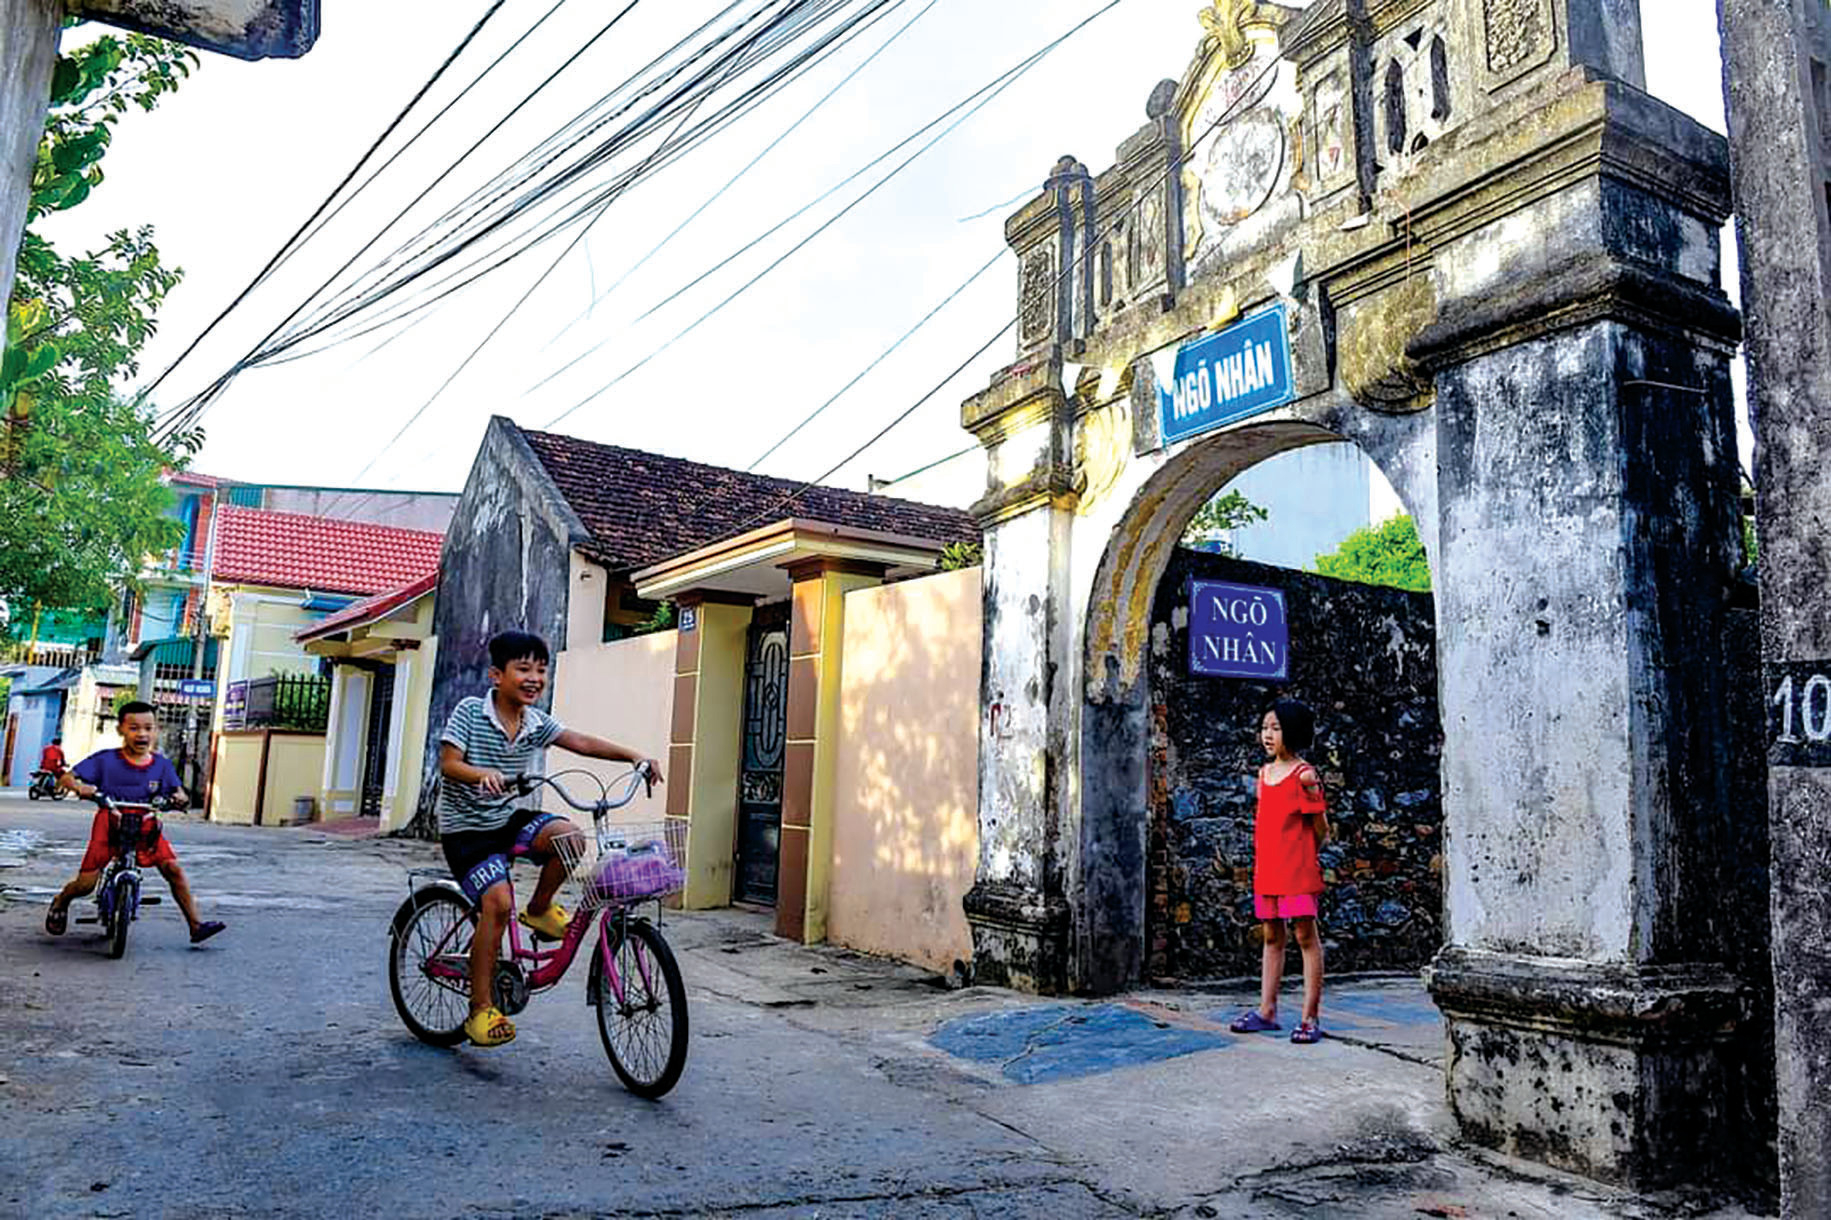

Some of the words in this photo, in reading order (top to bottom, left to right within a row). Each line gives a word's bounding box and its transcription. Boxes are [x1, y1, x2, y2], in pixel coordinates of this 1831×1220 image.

[1214, 339, 1274, 404] NHÂN
[1212, 595, 1267, 626] NGÕ
[1203, 631, 1276, 665] NHÂN
